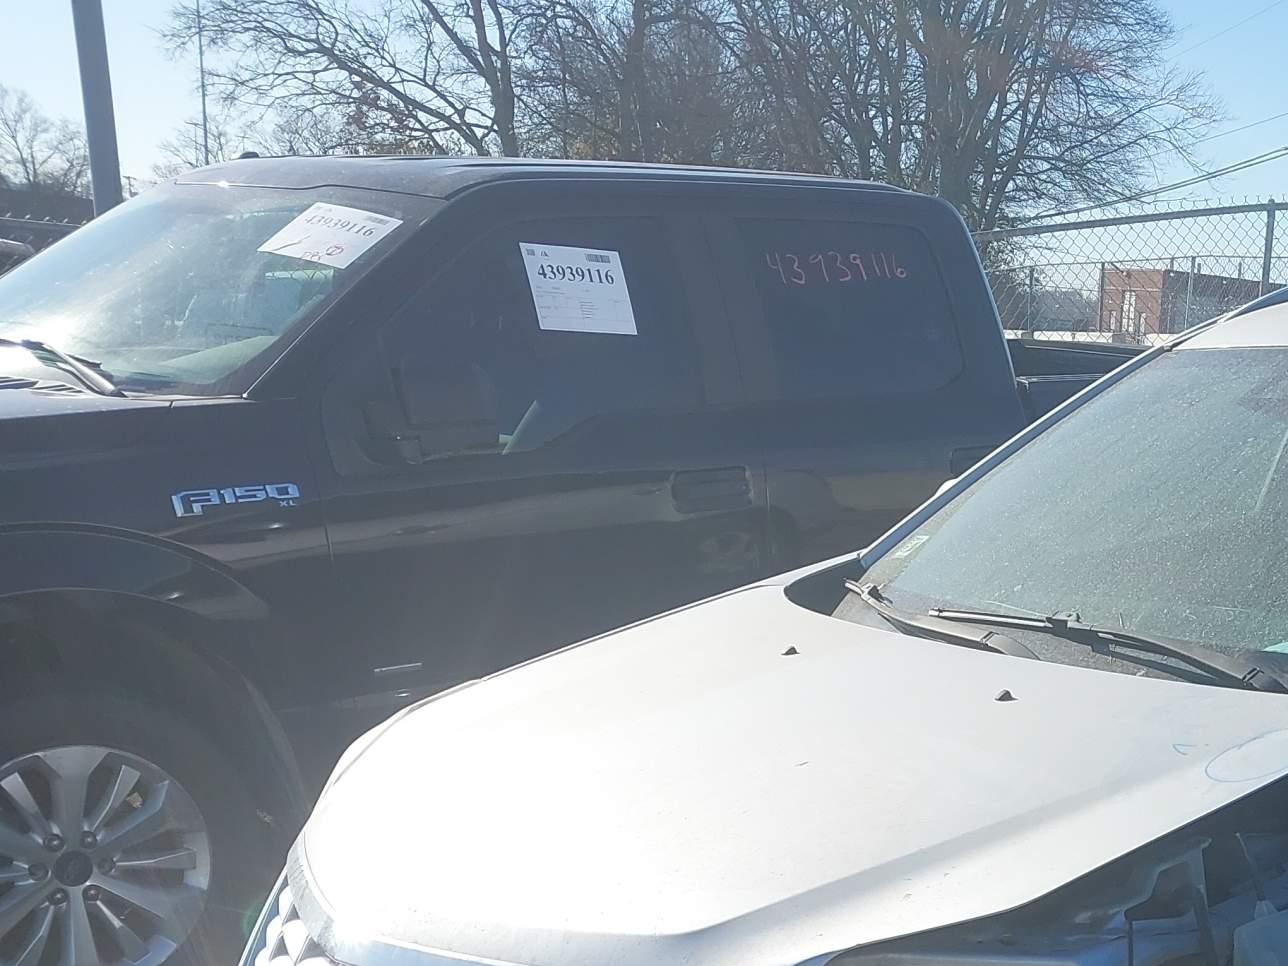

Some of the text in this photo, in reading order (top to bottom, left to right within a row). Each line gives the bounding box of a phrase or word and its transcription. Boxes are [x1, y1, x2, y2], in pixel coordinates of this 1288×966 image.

[305, 215, 375, 237] 43939116
[538, 264, 614, 284] 43939116
[766, 252, 907, 284] 43939116
[171, 482, 300, 517] F150
